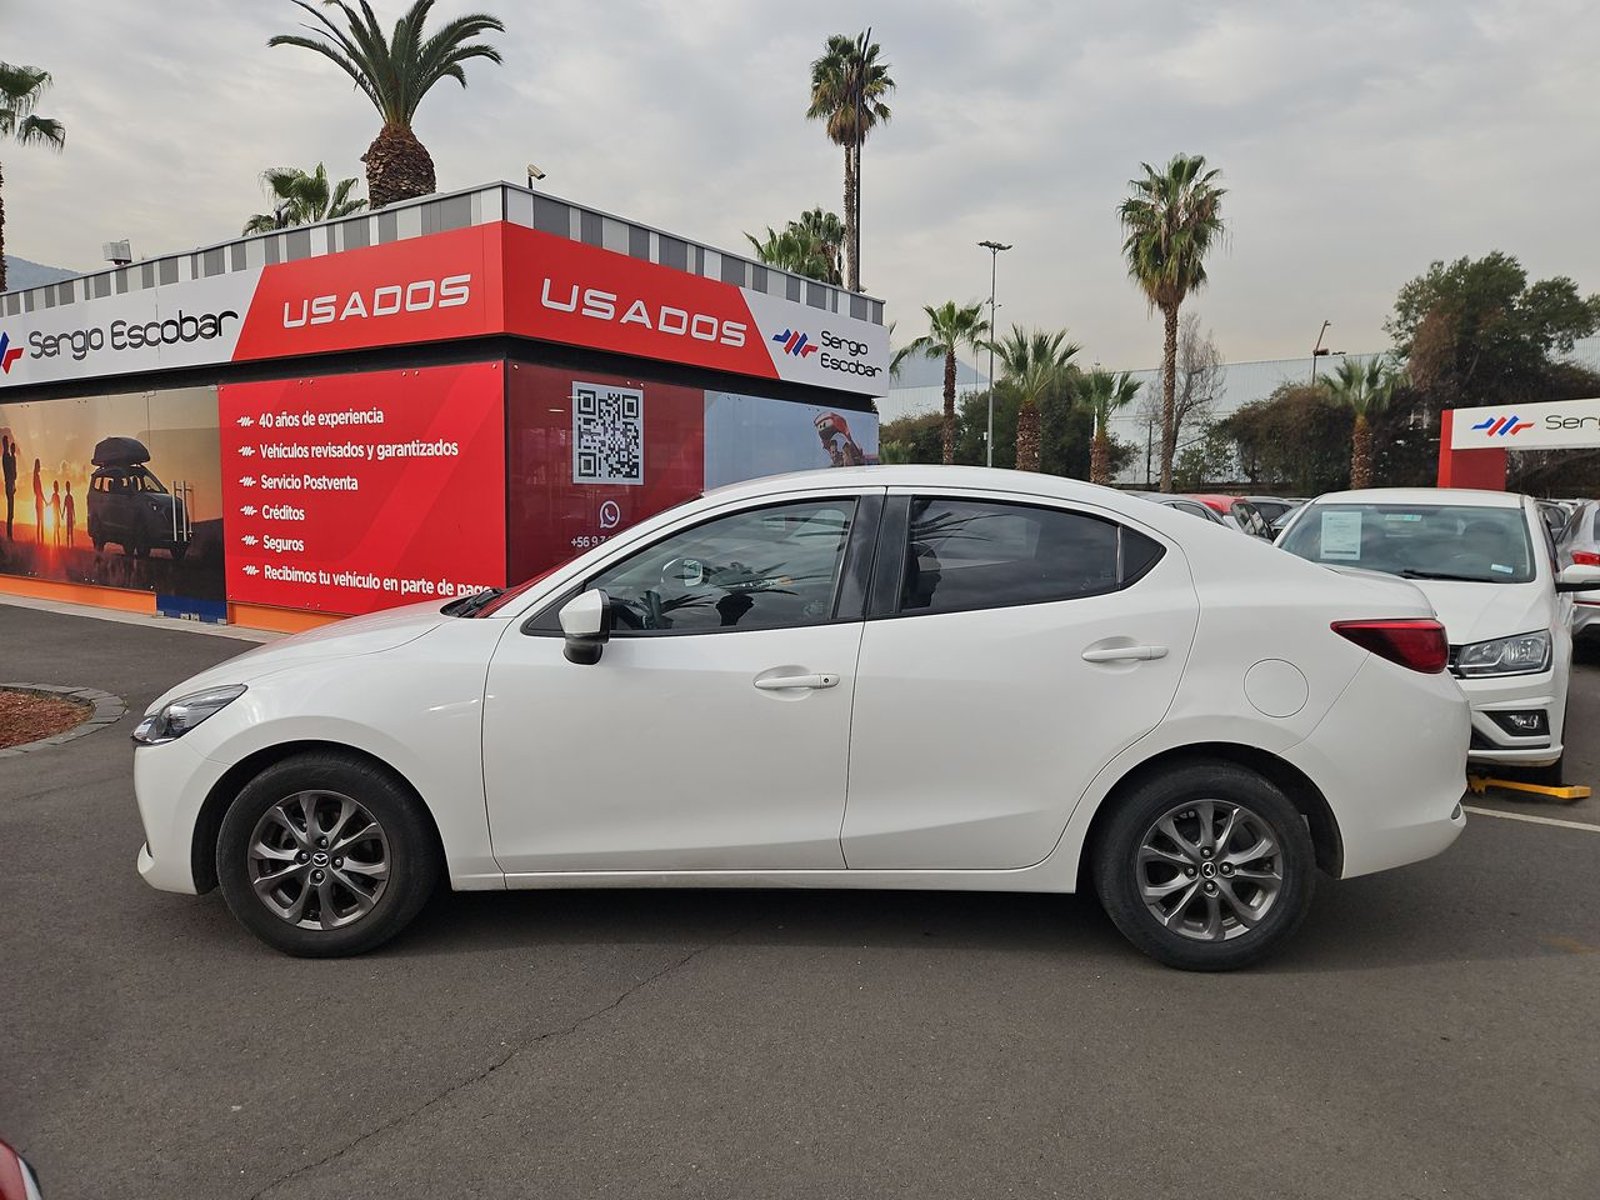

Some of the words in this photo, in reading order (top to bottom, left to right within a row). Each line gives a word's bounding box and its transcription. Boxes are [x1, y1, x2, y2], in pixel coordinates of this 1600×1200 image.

[283, 274, 471, 329] USADOS
[540, 278, 748, 348] USADOS
[29, 327, 104, 361] Sergio
[110, 310, 239, 351] Escobar
[821, 330, 868, 357] Sergio
[820, 352, 883, 378] Escobar
[259, 413, 273, 427] 40
[275, 411, 300, 427] años
[302, 410, 315, 426] de
[318, 407, 384, 428] experiencia
[1545, 414, 1600, 431] Ser
[260, 442, 309, 459] Vehículos
[311, 442, 364, 458] revisados
[366, 446, 374, 460] y
[377, 439, 459, 460] garantizados
[261, 475, 301, 489] Servicio
[303, 475, 358, 490] Postventa
[262, 504, 305, 521] Créditos
[263, 535, 304, 553] Seguros
[570, 535, 590, 548] +56
[264, 564, 317, 584] Recibimos
[319, 569, 330, 585] tu
[333, 570, 380, 589] vehículo
[383, 578, 398, 591] en
[400, 579, 434, 596] parte
[437, 578, 454, 596] de
